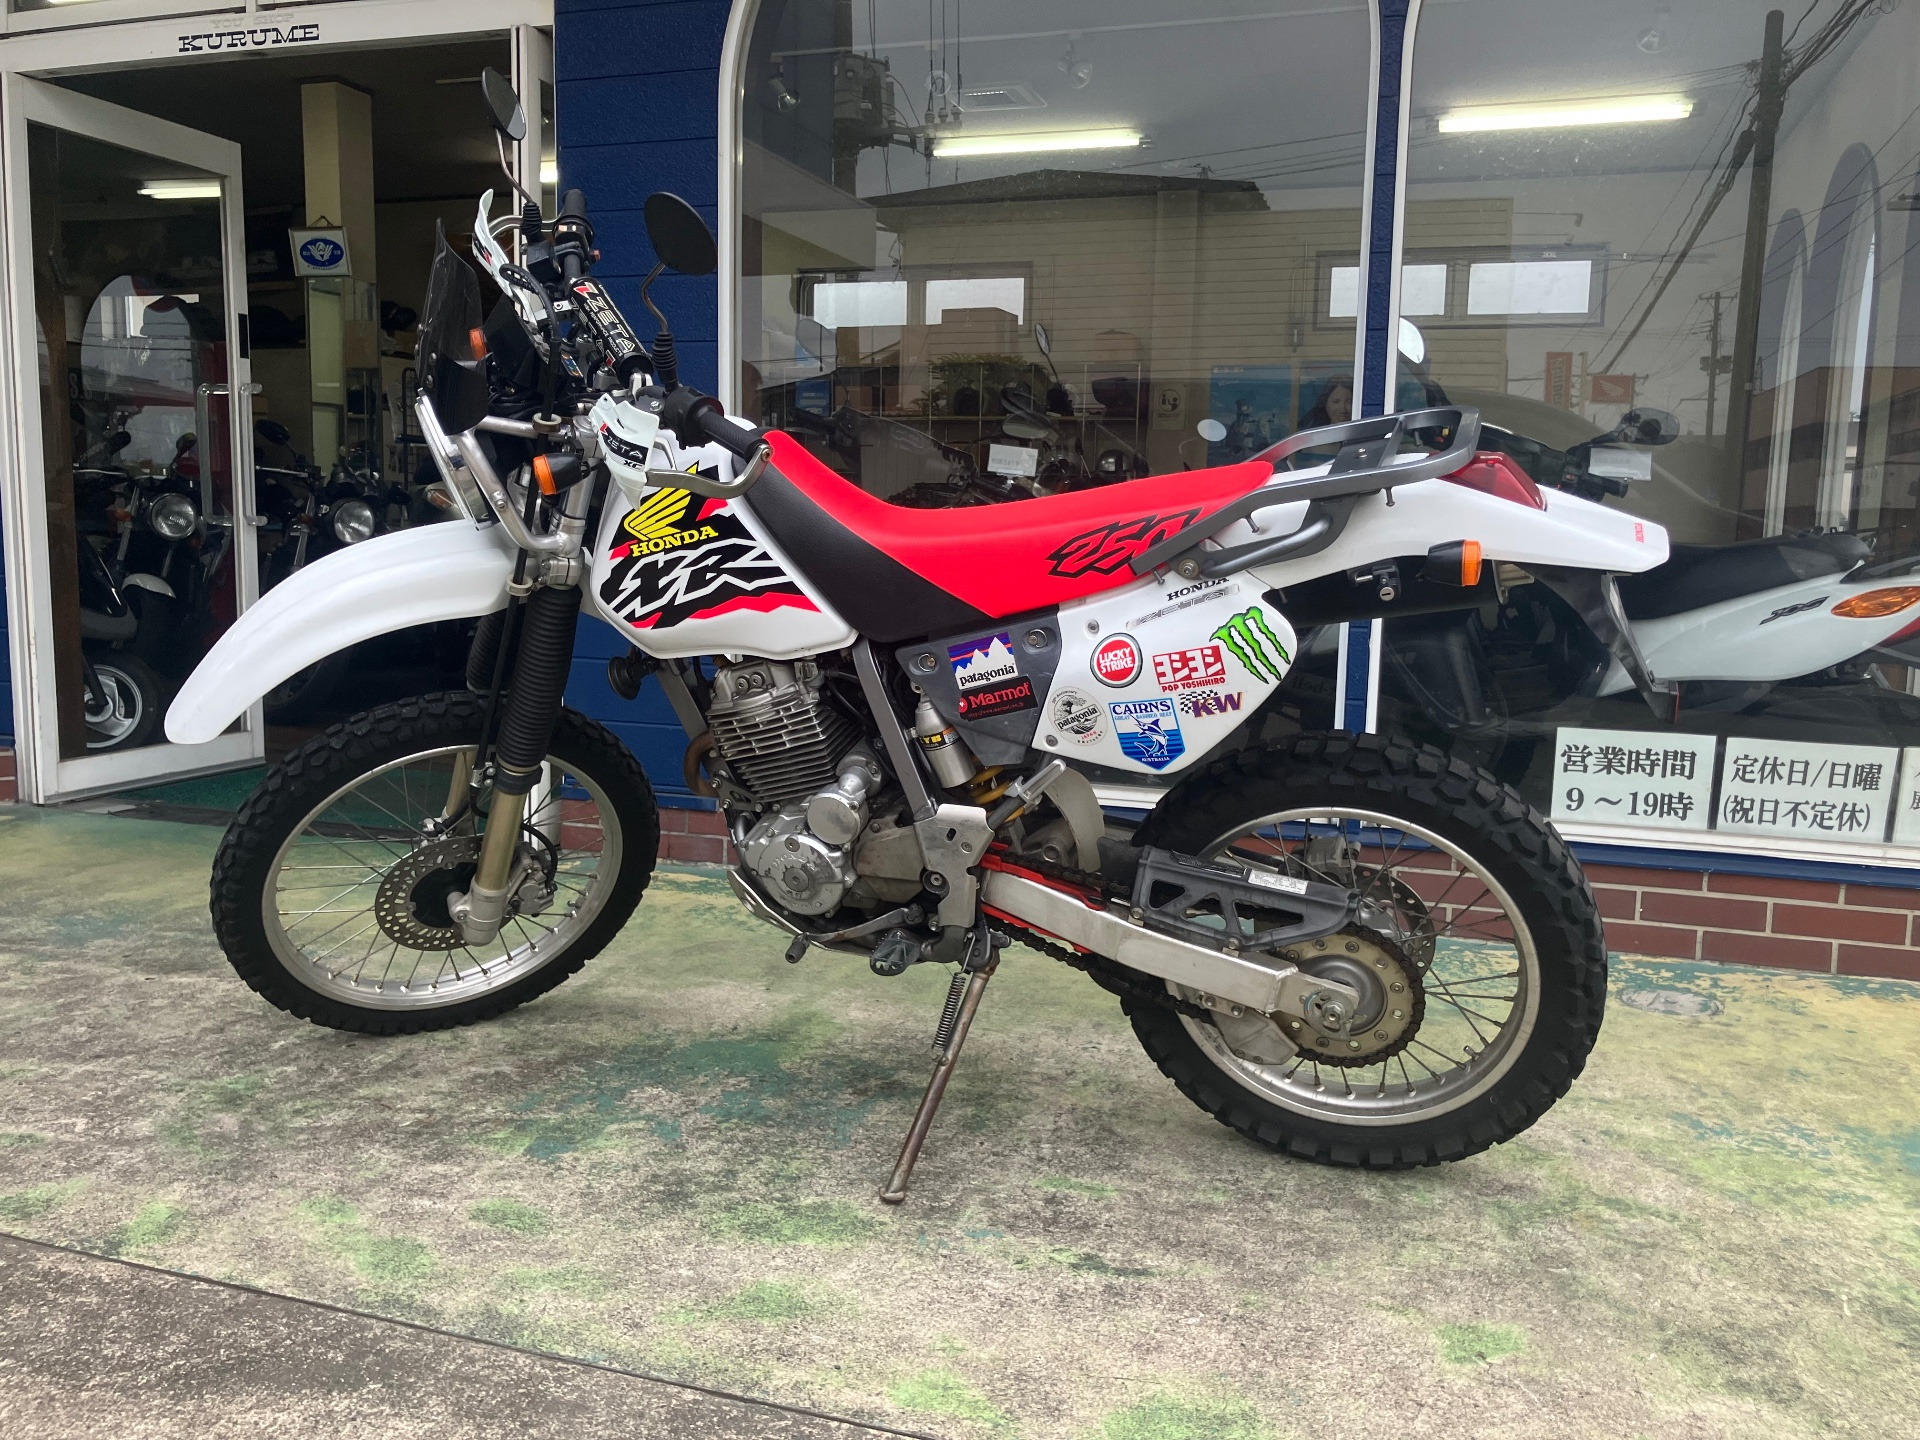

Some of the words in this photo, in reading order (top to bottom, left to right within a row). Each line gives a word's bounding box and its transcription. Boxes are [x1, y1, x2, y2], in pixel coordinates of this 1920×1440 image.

[178, 24, 319, 52] KURUME
[587, 297, 635, 353] ZETA
[608, 436, 643, 459] ZETA
[630, 525, 718, 558] HONDA
[609, 537, 794, 619] XR
[1167, 577, 1229, 601] HONDA
[1099, 647, 1131, 662] LUCKY
[1100, 657, 1134, 674] STRIKE
[959, 664, 1015, 686] patagonia
[1162, 684, 1179, 693] POP
[1181, 677, 1226, 690] YOSHIHIRO
[968, 682, 1031, 708] Marmot
[1112, 700, 1171, 715] CAIRNS
[1192, 692, 1242, 718] KW
[1057, 707, 1098, 730] patagonia
[1560, 743, 1697, 780] 営業時間
[1730, 753, 1883, 792] 定休日/日曜
[1723, 794, 1871, 833] (祝日不定休)
